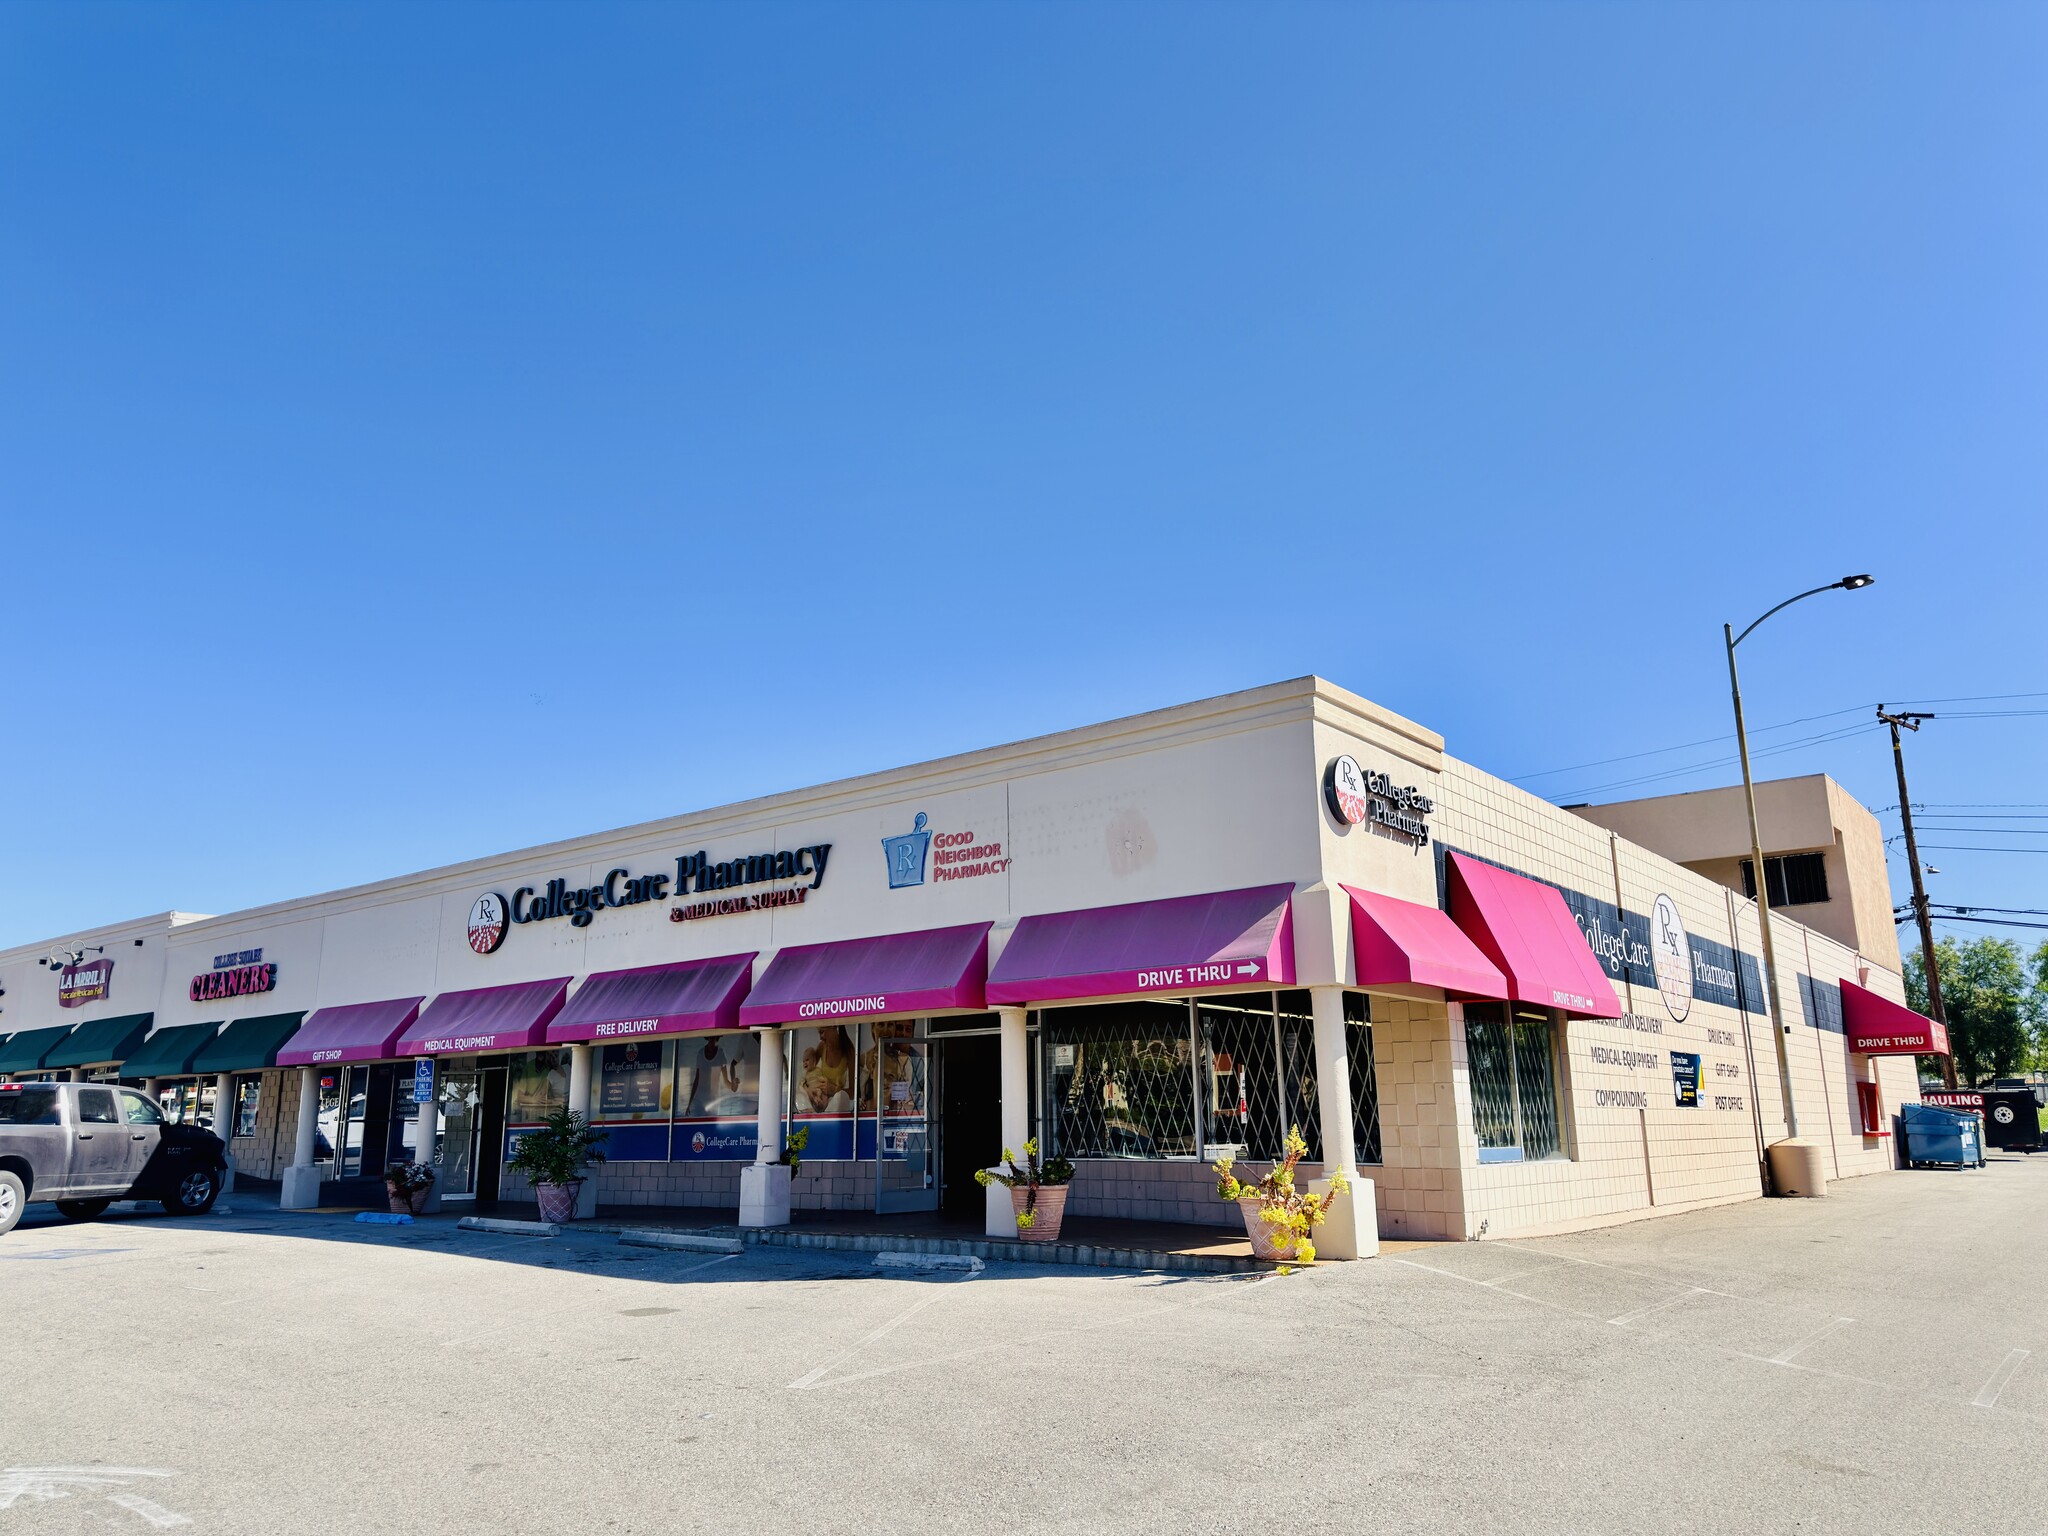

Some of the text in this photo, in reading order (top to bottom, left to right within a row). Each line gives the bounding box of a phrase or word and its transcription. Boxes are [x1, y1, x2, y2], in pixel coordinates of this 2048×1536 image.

[1363, 768, 1434, 813] CollegeCare
[1373, 798, 1429, 846] Pharmacy
[933, 831, 974, 849] GOOD
[933, 843, 1001, 866] NEIGHBOR
[933, 858, 1008, 883] PHARMACY
[510, 844, 832, 927] CollegeCare Pharmacy
[669, 887, 808, 922] & MEDICAL SUPPLY
[190, 963, 275, 1001] CLEANERS
[1137, 964, 1231, 988] DRIVE THRU
[1692, 949, 1737, 1000] Pharmacy
[799, 996, 885, 1017] COMPOUNDING
[1552, 990, 1586, 1009] DRIVE THRU
[596, 1019, 659, 1036] FREE DELIVERY
[1635, 1014, 1663, 1035] DELIVERY
[424, 1035, 496, 1051] MEDICAL EQUIPMENT
[1707, 1028, 1735, 1046] DRIVE THRU
[1857, 1036, 1924, 1048] DRIVE THRU
[312, 1049, 343, 1061] GIFT SHOP
[1591, 1046, 1658, 1071] MEDICAL EQUIPMENT
[1715, 1063, 1739, 1078] GIFT SHOP
[1595, 1089, 1647, 1108] COMPOUNDING
[1714, 1096, 1728, 1110] POST
[1728, 1097, 1743, 1111] OFFICE
[1920, 1095, 1983, 1106] HAULING
[706, 1136, 738, 1150] CollegeCare
[739, 1135, 758, 1146] Pharm
